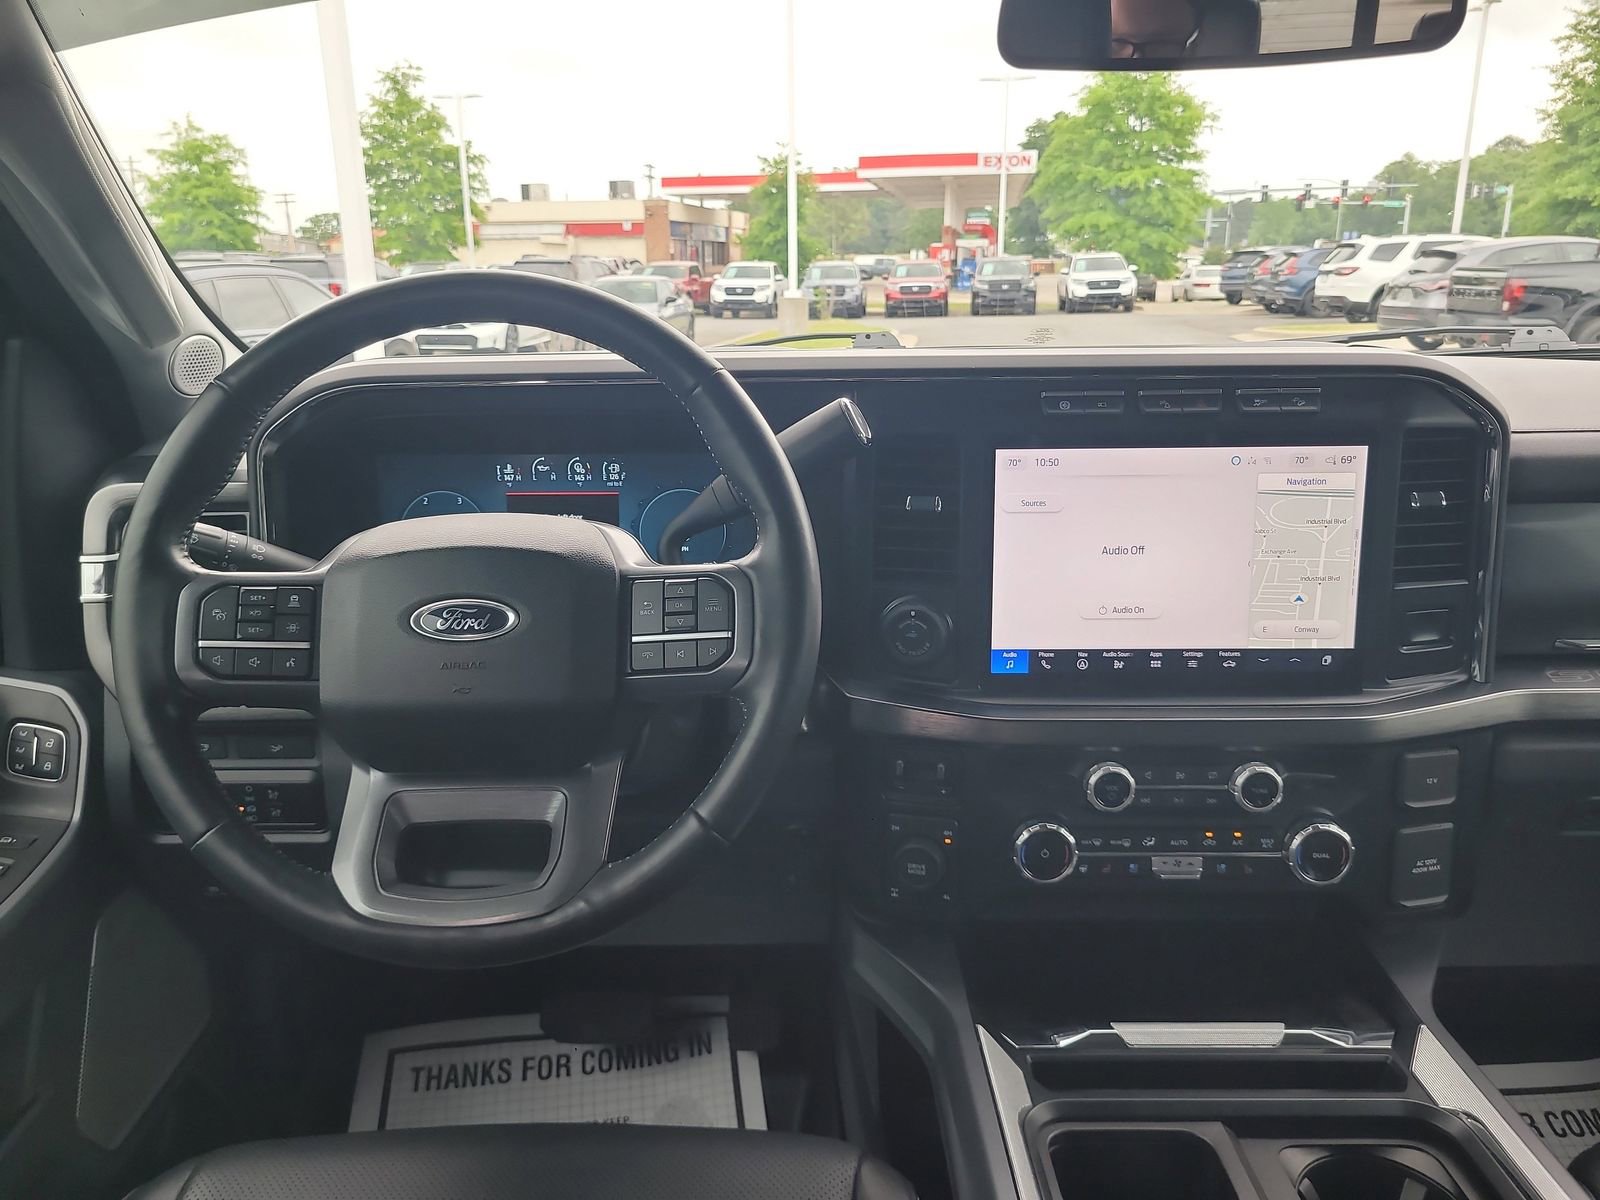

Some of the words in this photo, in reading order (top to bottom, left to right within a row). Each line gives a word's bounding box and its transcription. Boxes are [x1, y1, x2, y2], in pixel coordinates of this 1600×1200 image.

[1034, 457, 1060, 467] 10:50
[1340, 455, 1357, 464] 69°
[1286, 477, 1327, 486] Navigation
[423, 497, 428, 505] 2
[457, 497, 463, 505] 3
[1020, 499, 1047, 507] Sources
[1101, 545, 1129, 555] Audio
[1130, 545, 1145, 555] Off
[1260, 548, 1286, 556] Exchange
[1112, 606, 1134, 614] Audio
[1135, 606, 1145, 614] On
[436, 607, 490, 630] Ford
[1294, 626, 1319, 634] Conway
[1149, 651, 1163, 659] Apps
[439, 661, 488, 671] AIRBAG
[1312, 851, 1331, 859] DUAL
[411, 1057, 512, 1093] THANKS
[521, 1053, 572, 1083] FOR
[581, 1038, 681, 1076] COMING
[689, 1031, 713, 1059] IN
